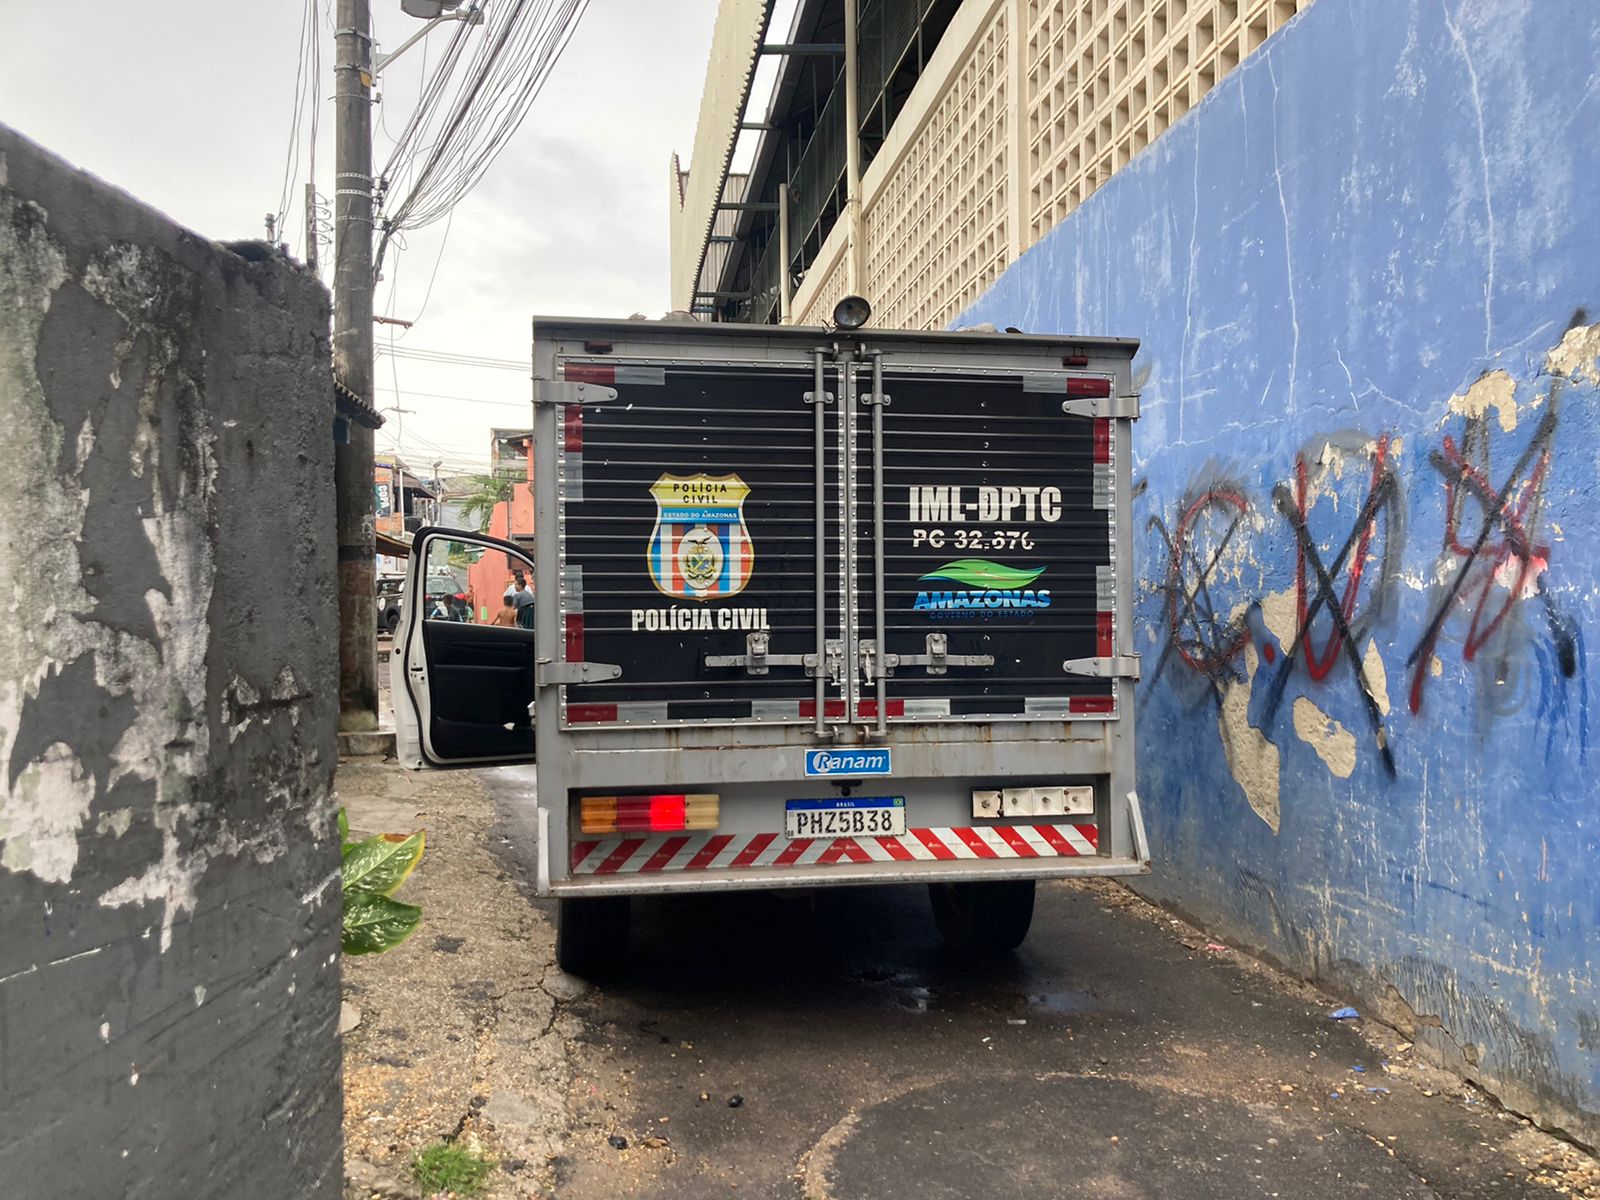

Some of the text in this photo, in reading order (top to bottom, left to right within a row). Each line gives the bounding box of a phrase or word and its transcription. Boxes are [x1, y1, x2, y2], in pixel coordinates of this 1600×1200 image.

[673, 482, 728, 493] POLÍCIA
[682, 495, 718, 504] CIVIL
[909, 486, 1062, 523] IML-DPTC
[912, 529, 946, 549] PC
[913, 590, 1051, 611] AMAZONAS
[631, 604, 770, 632] POLÍCIA CIVIL
[929, 611, 976, 620] GOVERNO
[998, 609, 1035, 618] ESTADO
[812, 752, 884, 773] Ranam
[796, 810, 893, 835] PHZ5B38
